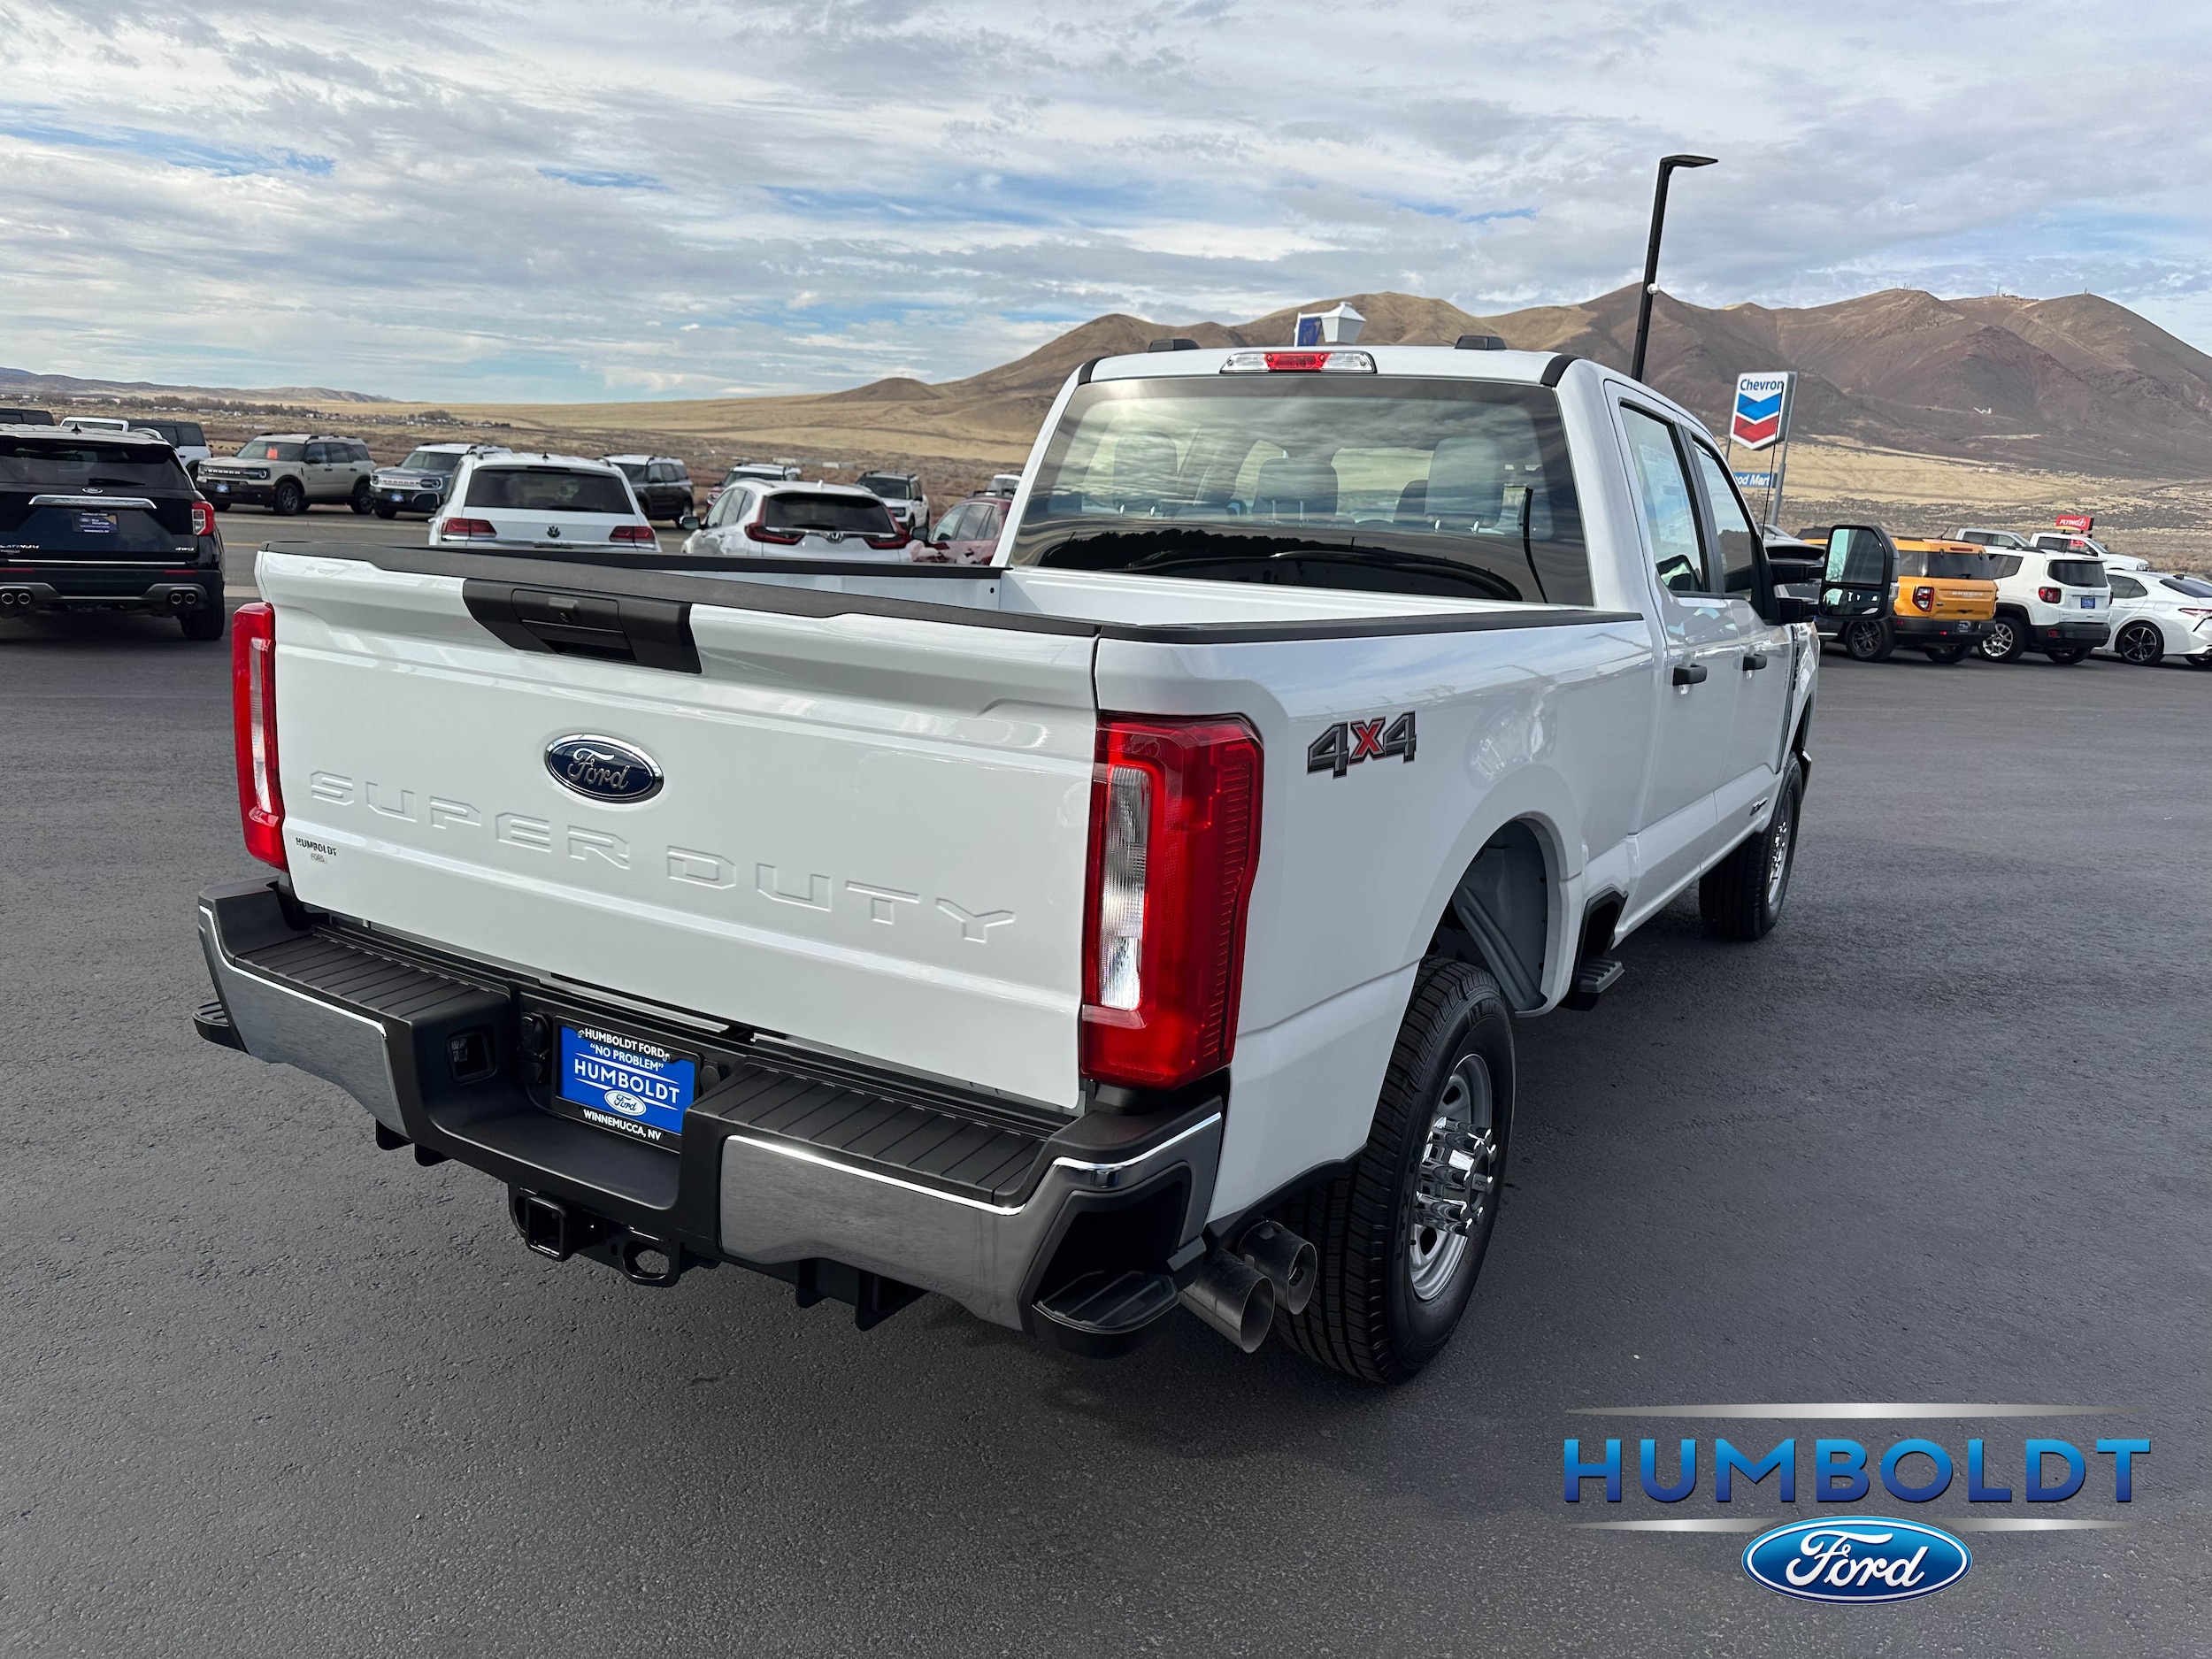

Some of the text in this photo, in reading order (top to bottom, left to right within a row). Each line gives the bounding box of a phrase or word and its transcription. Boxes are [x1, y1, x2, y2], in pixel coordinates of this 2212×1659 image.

[1740, 379, 1784, 390] Chevron
[566, 747, 631, 791] Ford
[296, 837, 337, 856] HUMBOLDT
[311, 771, 1017, 944] SUPER DUTY
[584, 1028, 664, 1059] HUMBOLDT FORD
[574, 1058, 680, 1104] HUMBOLDT
[613, 1094, 637, 1111] Ford
[583, 1109, 662, 1141] WINNEMUCCA, NV
